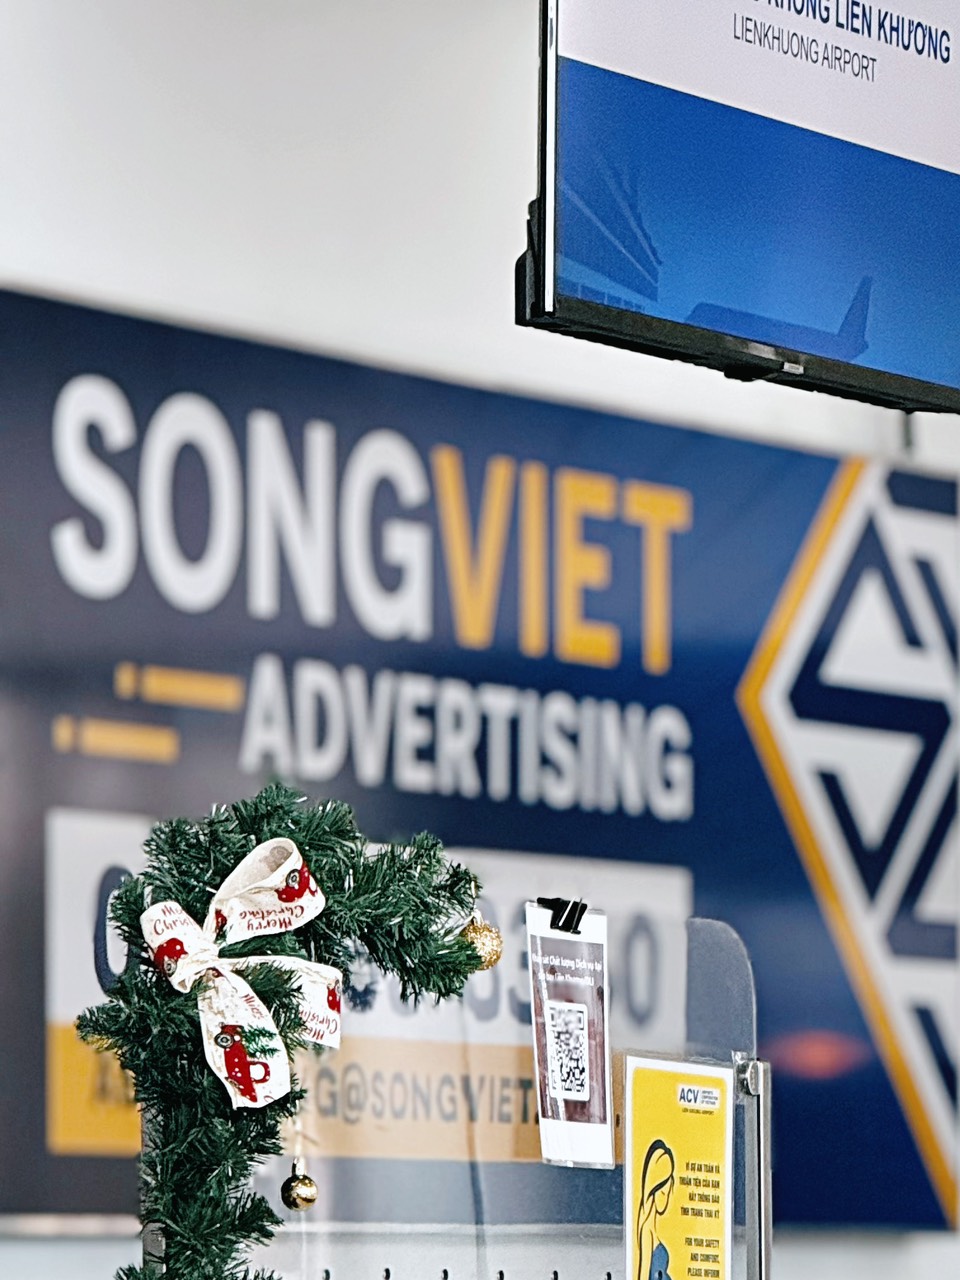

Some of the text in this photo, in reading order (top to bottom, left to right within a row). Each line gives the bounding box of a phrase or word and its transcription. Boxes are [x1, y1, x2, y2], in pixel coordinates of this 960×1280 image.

[733, 13, 877, 82] LIENKHUONG AIRPORT
[878, 8, 951, 63] KHƯƠNG
[238, 652, 694, 822] ADVERTISING
[679, 1087, 699, 1104] ACV
